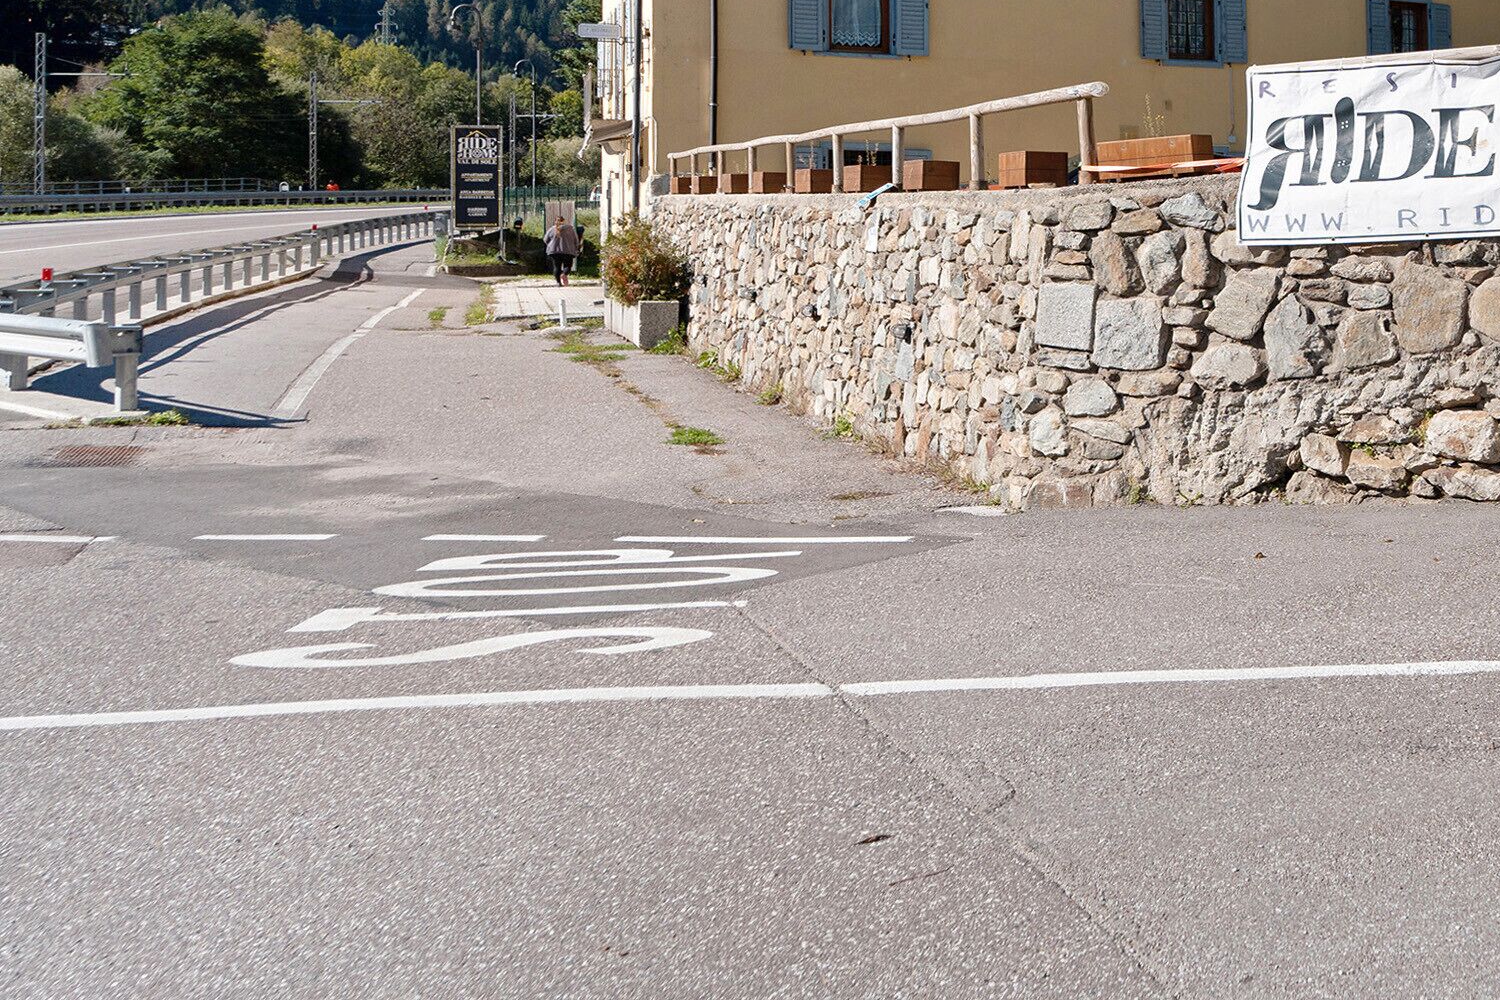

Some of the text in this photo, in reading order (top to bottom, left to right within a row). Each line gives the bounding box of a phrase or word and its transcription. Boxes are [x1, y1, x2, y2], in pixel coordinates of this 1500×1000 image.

[457, 133, 497, 152] RIDE
[1247, 96, 1496, 212] RIDE
[229, 549, 802, 669] STOP
